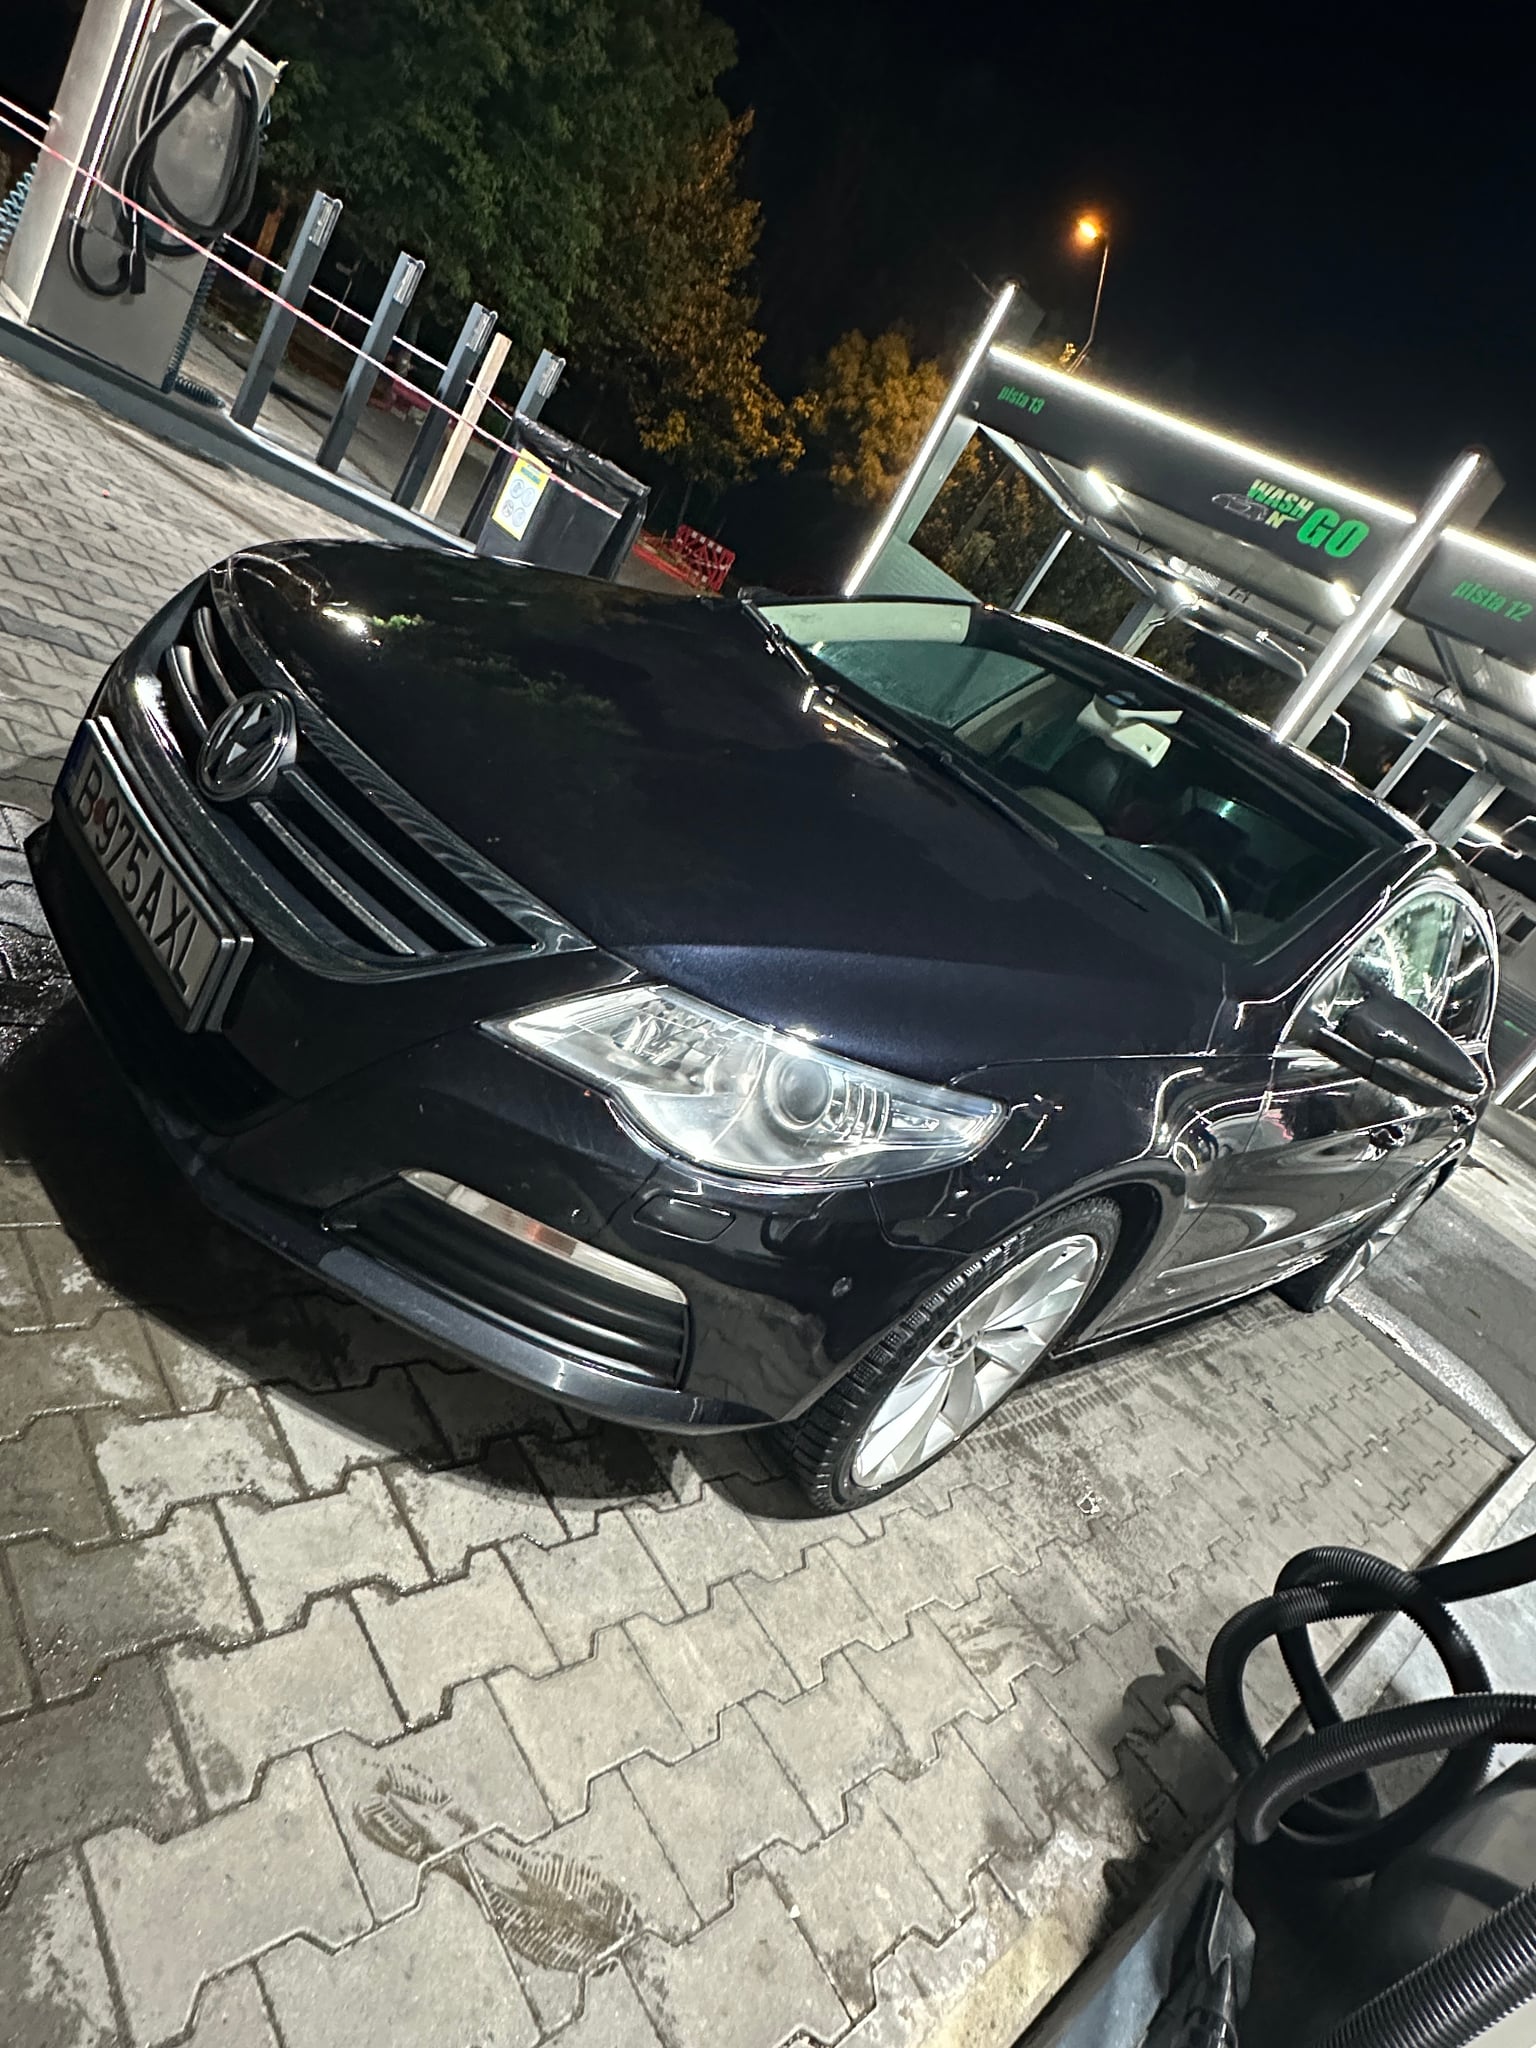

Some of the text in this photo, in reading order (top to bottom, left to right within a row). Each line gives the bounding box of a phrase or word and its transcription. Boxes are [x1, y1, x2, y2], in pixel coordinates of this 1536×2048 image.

[1029, 397, 1045, 414] 13
[1247, 479, 1315, 519] WASH
[1296, 507, 1370, 558] GO
[1504, 601, 1533, 622] 12
[77, 764, 103, 826] B
